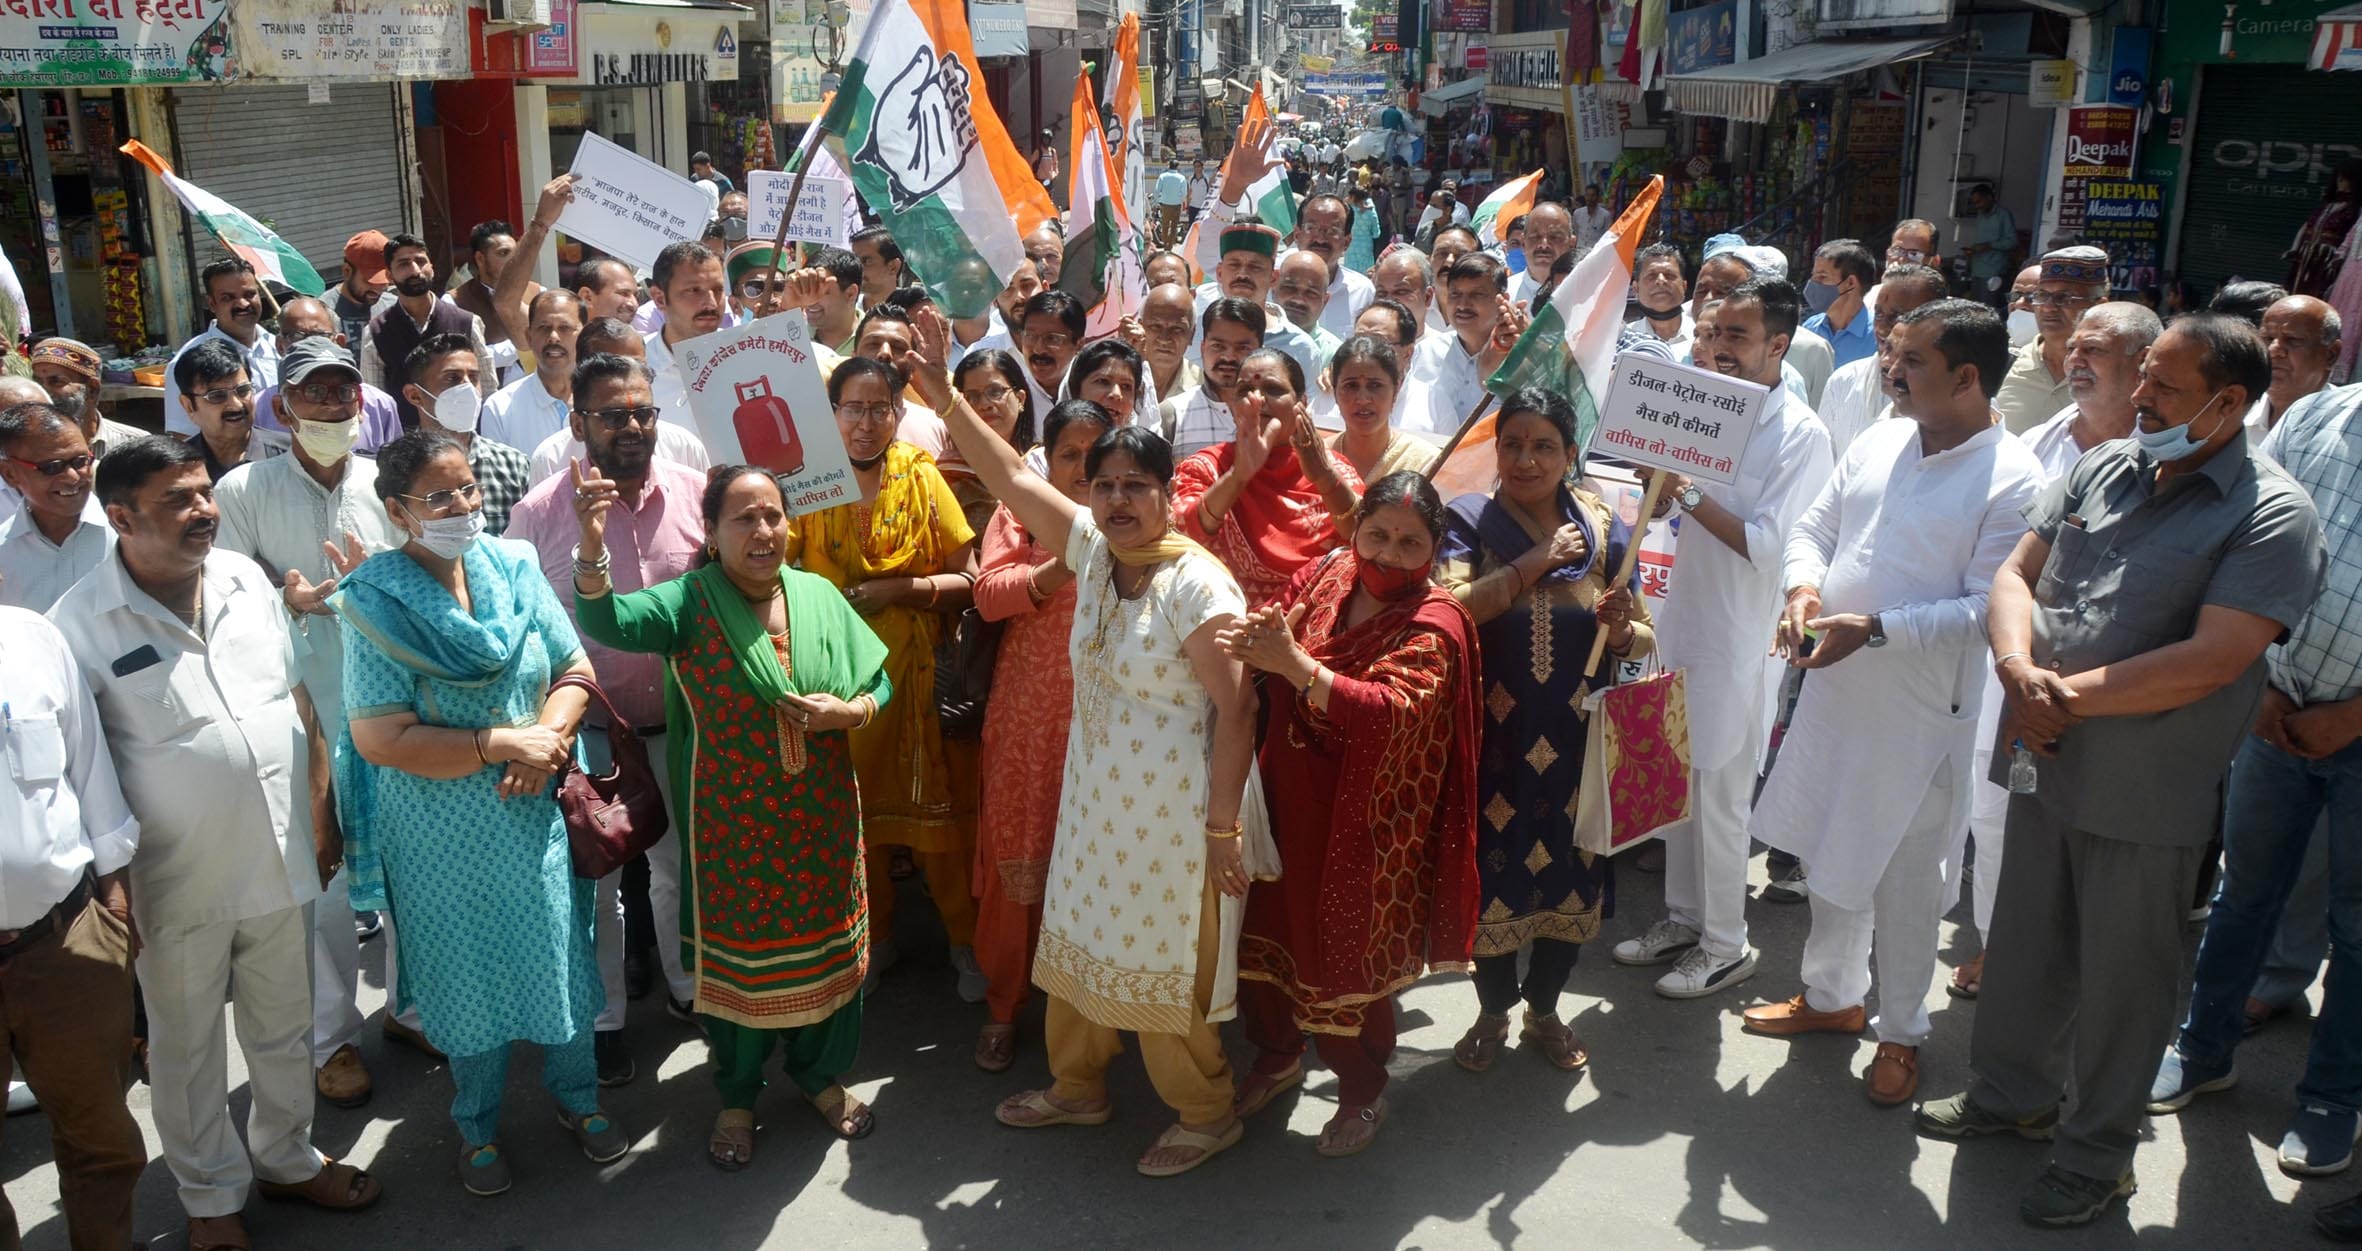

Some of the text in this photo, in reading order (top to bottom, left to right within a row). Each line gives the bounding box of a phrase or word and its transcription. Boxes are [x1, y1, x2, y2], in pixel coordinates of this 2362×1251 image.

[261, 23, 306, 35] TRAINING
[381, 24, 402, 36] ONLY
[408, 25, 434, 35] LADIES
[2237, 18, 2314, 34] Camera
[537, 36, 566, 49] SPOT
[98, 43, 108, 60] के
[281, 49, 302, 60] SPL
[2115, 76, 2141, 91] Jio
[2068, 135, 2130, 164] Deepak
[2213, 140, 2362, 183] opp
[768, 178, 824, 193] मोदी राज
[2088, 183, 2160, 200] DEEPAK
[625, 192, 639, 205] तेरे
[641, 200, 658, 214] राज
[659, 209, 668, 219] के
[669, 214, 686, 228] हाल
[799, 196, 817, 207] लगी
[820, 196, 827, 209] है
[2087, 200, 2133, 217] Mehandi
[2136, 201, 2160, 218] Arts
[632, 211, 661, 231] किसान
[759, 221, 776, 233] और
[787, 224, 803, 237] सोई
[806, 224, 822, 237] गैस
[737, 336, 766, 351] कमेटी
[769, 340, 807, 364] हमीरपुर
[1635, 402, 1660, 422] गैस
[1662, 411, 1681, 428] की
[1606, 429, 1646, 450] वापिस
[1715, 456, 1733, 473] लो
[830, 484, 844, 498] लो
